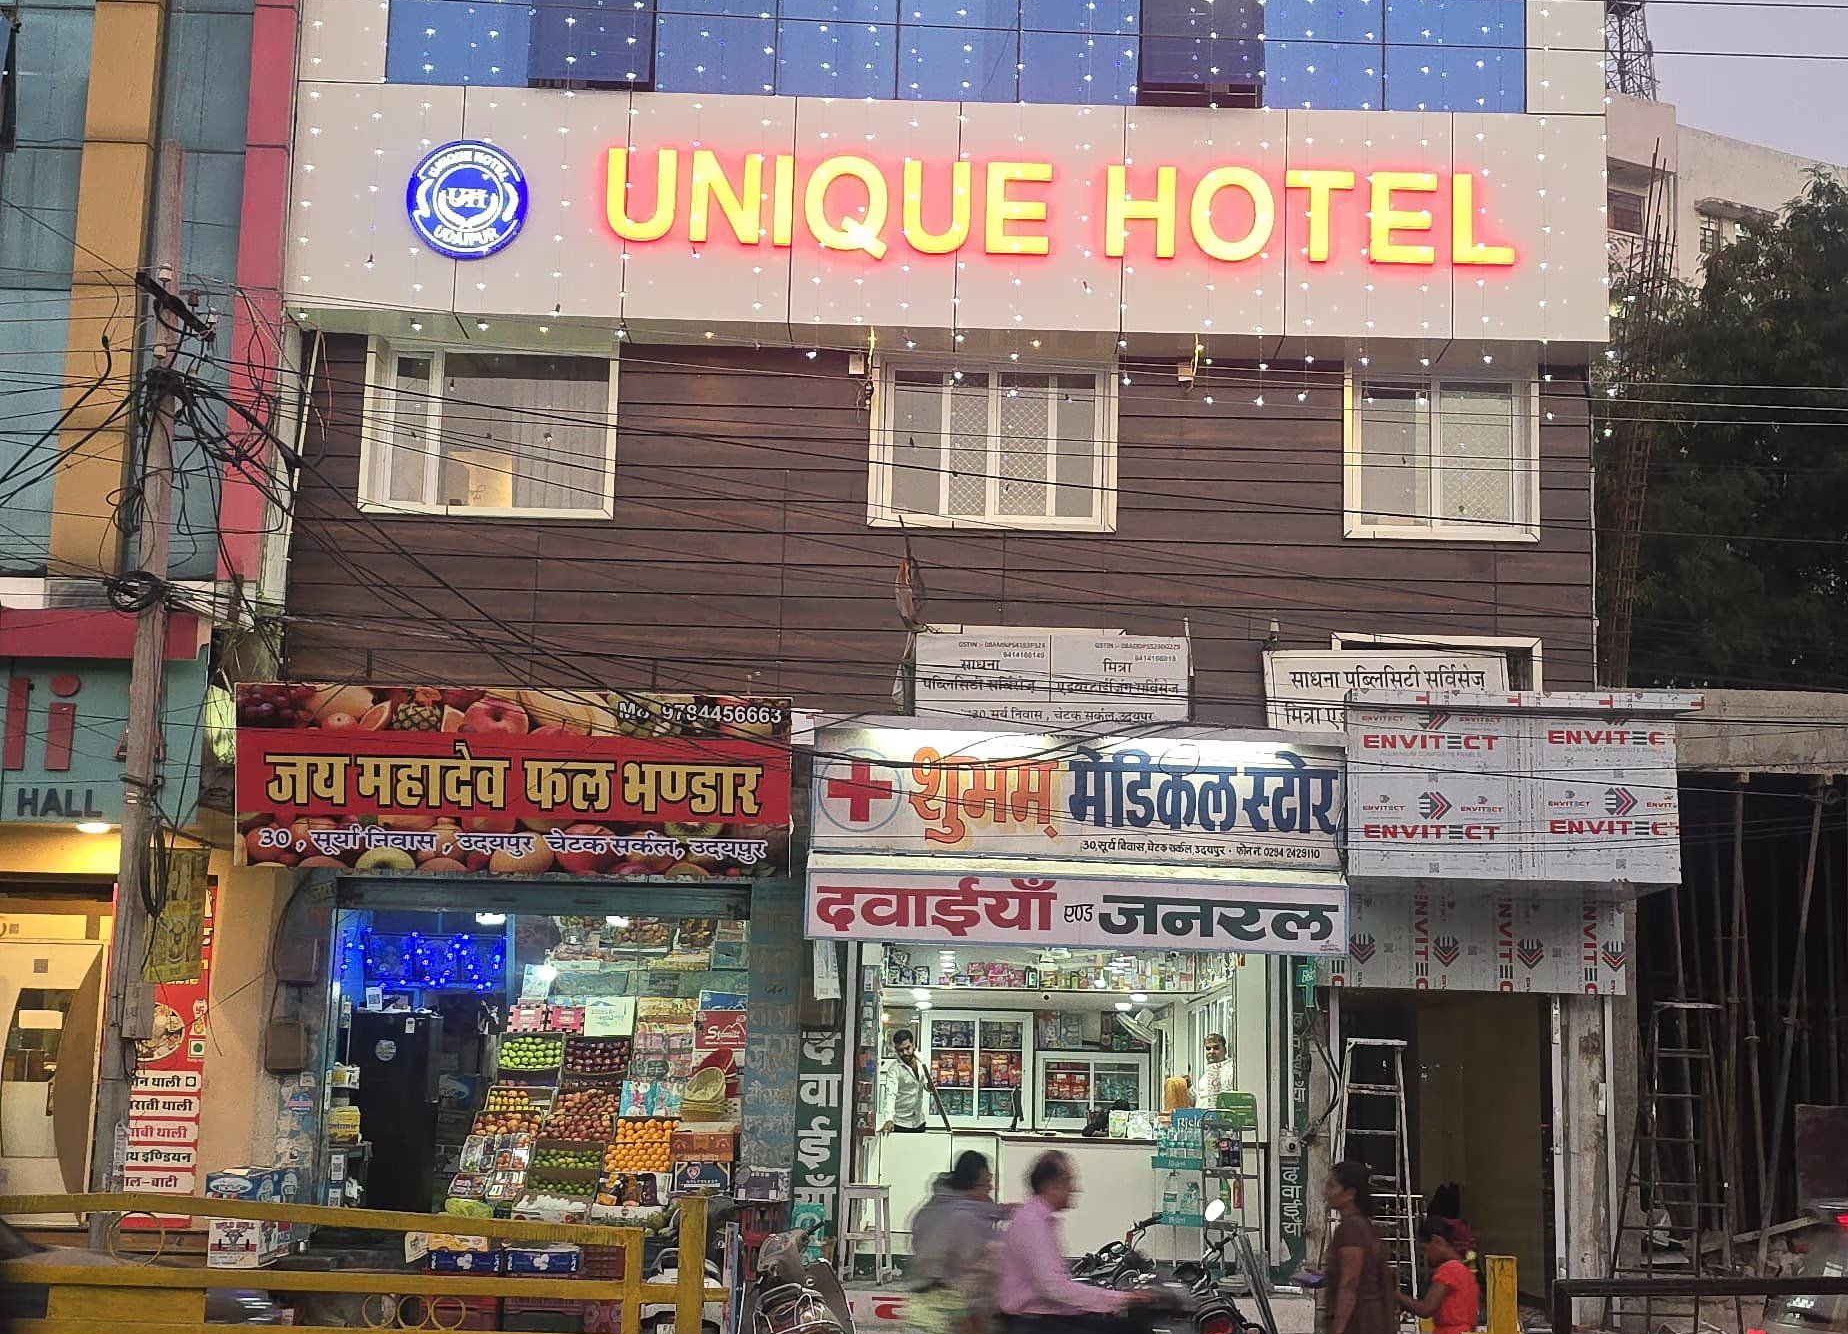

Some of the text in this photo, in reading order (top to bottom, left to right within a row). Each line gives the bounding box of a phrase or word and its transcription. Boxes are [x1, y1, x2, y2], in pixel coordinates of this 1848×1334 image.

[606, 147, 1516, 266] UNIQUE HOTEL
[1102, 657, 1133, 673] मित्रा
[1289, 670, 1341, 689] साधना
[1343, 664, 1421, 690] पब्लिसिटी
[1363, 734, 1499, 750] ENVITECT
[264, 740, 764, 816] जय महादेव फल भण्डार
[1069, 745, 1237, 832] मेडिकल
[1242, 750, 1339, 836] स्टोर
[16, 787, 103, 818] HALL
[1363, 824, 1502, 840] ENVITECT
[454, 832, 536, 859] उदयपुर
[544, 828, 606, 854] चेटक
[688, 837, 769, 865] उदयपुर
[816, 876, 1058, 937] दवाईयाँ
[1098, 894, 1339, 942] जनरल
[151, 1075, 181, 1088] थाली
[162, 1099, 193, 1112] थाली
[157, 1125, 188, 1139] थाली
